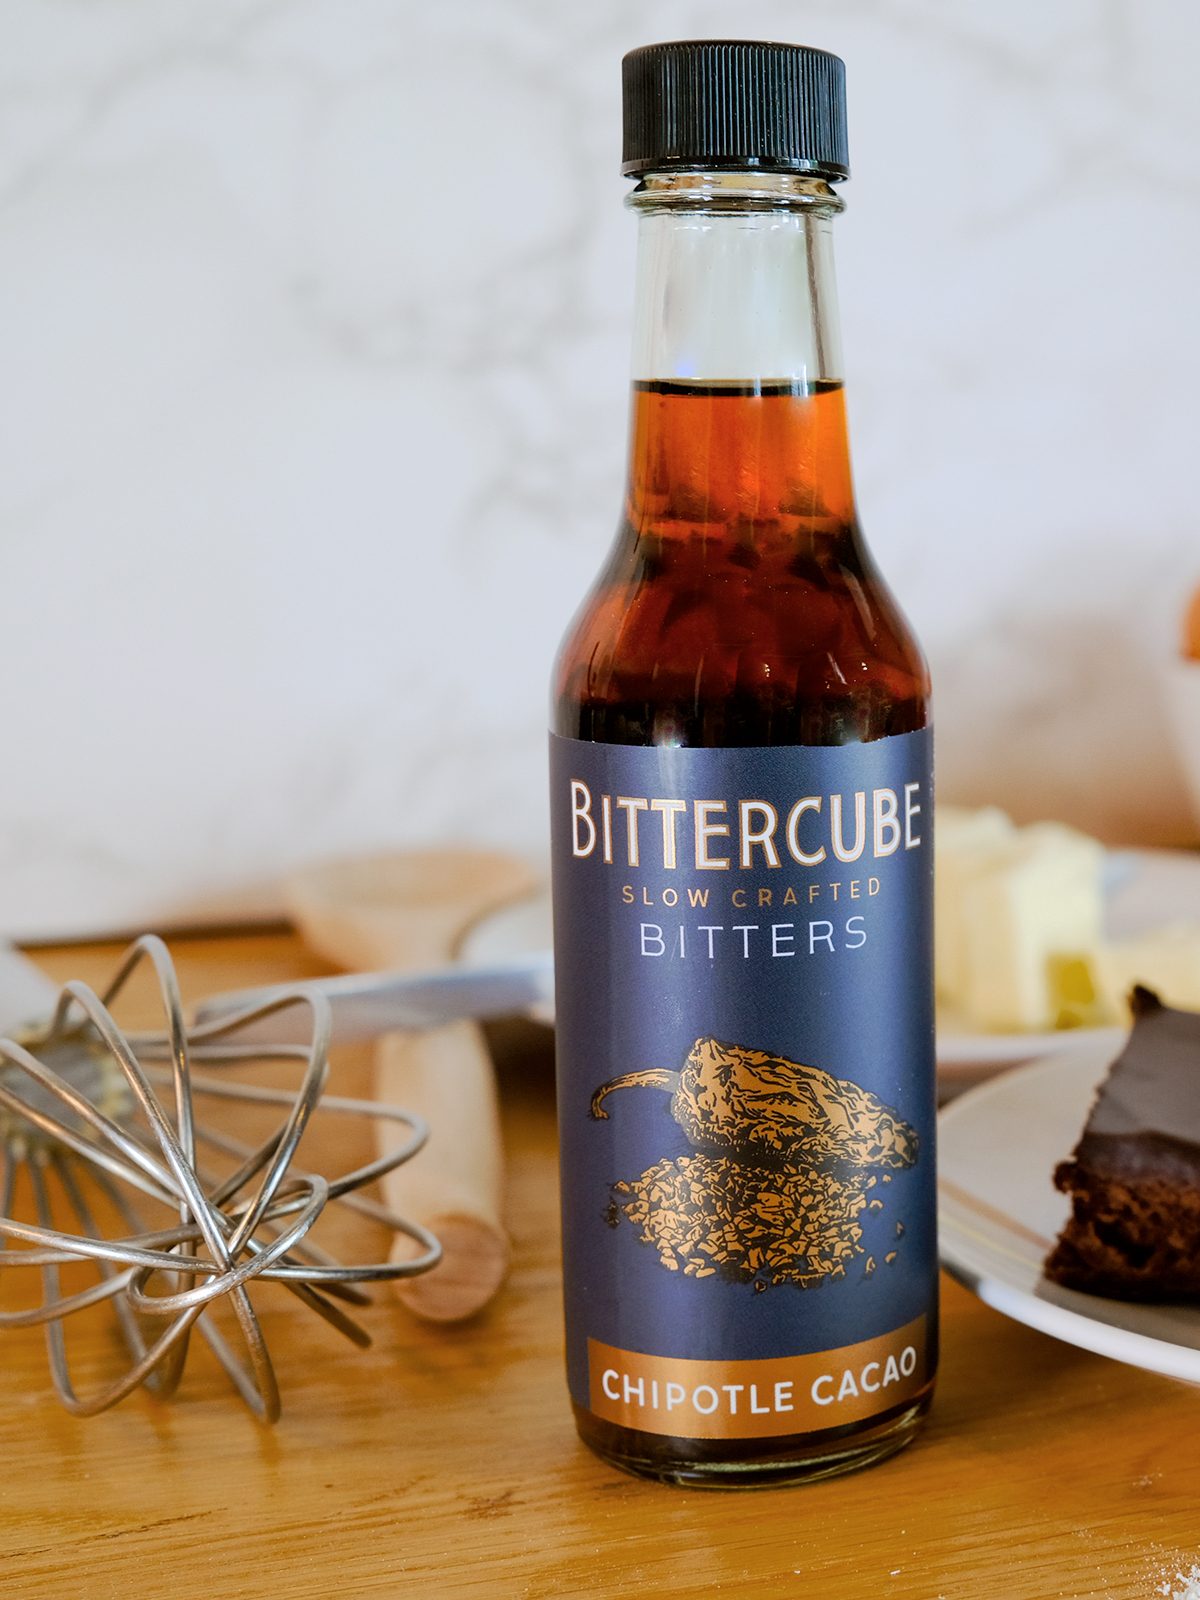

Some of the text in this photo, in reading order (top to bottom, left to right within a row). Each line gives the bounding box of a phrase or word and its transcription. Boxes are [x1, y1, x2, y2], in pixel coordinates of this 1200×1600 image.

[569, 777, 922, 870] BITTERCUBE
[621, 876, 881, 908] SLOW CRAFTED
[640, 915, 867, 959] BITTERS
[601, 1346, 917, 1415] CHIPOTLE CACAO
